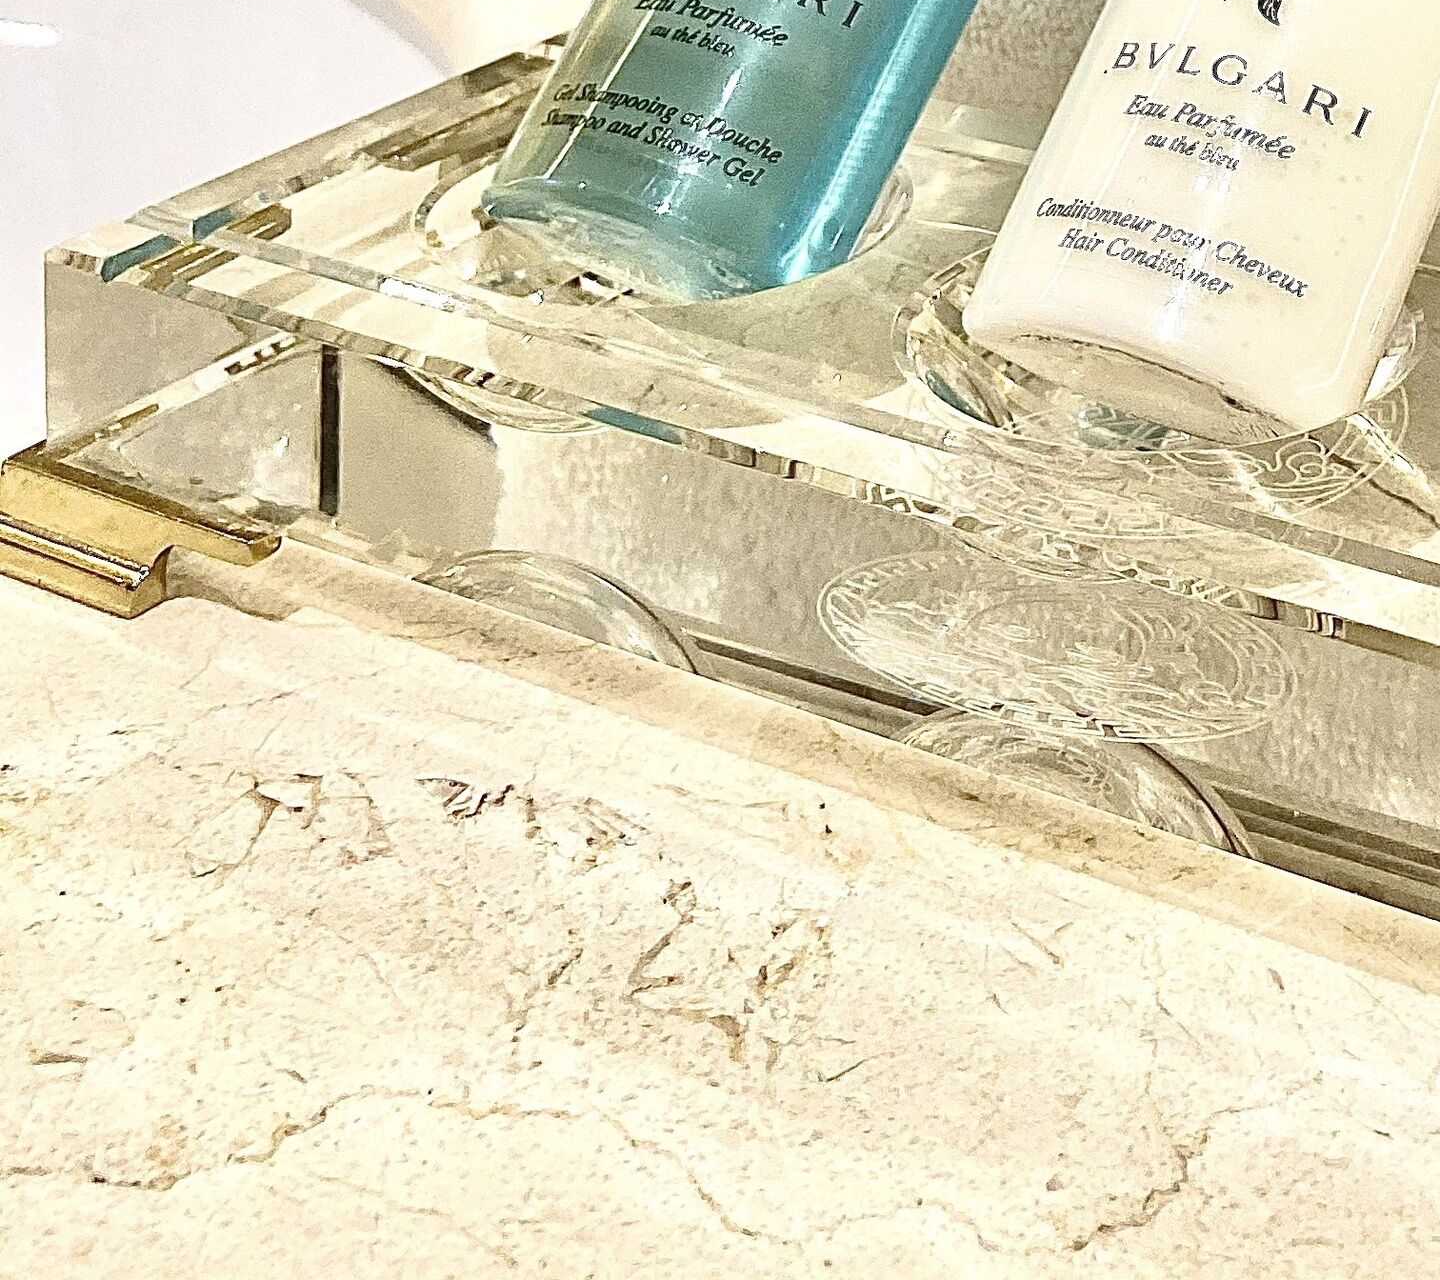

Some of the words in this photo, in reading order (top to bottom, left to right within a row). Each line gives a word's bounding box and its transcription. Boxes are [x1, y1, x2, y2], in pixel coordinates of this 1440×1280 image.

[650, 24, 667, 37] au
[671, 26, 699, 45] thé
[554, 84, 579, 101] Gel
[576, 83, 680, 124] Shampooing
[703, 117, 783, 164] Douche
[1112, 42, 1372, 139] BVLGARI
[1123, 95, 1170, 119] Eau
[1171, 102, 1297, 159] Parfumée
[541, 108, 607, 130] Shampoo
[606, 121, 647, 140] and
[643, 125, 722, 166] Shower
[723, 157, 765, 187] Gel
[1144, 134, 1166, 148] au
[1169, 135, 1200, 156] thé
[1199, 142, 1240, 171] bleu
[1036, 197, 1157, 233] Conditionneur
[1151, 222, 1213, 251] pour
[1214, 241, 1309, 298] Cheveux
[1058, 227, 1105, 252] Hair
[1105, 237, 1234, 295] Conditioner
